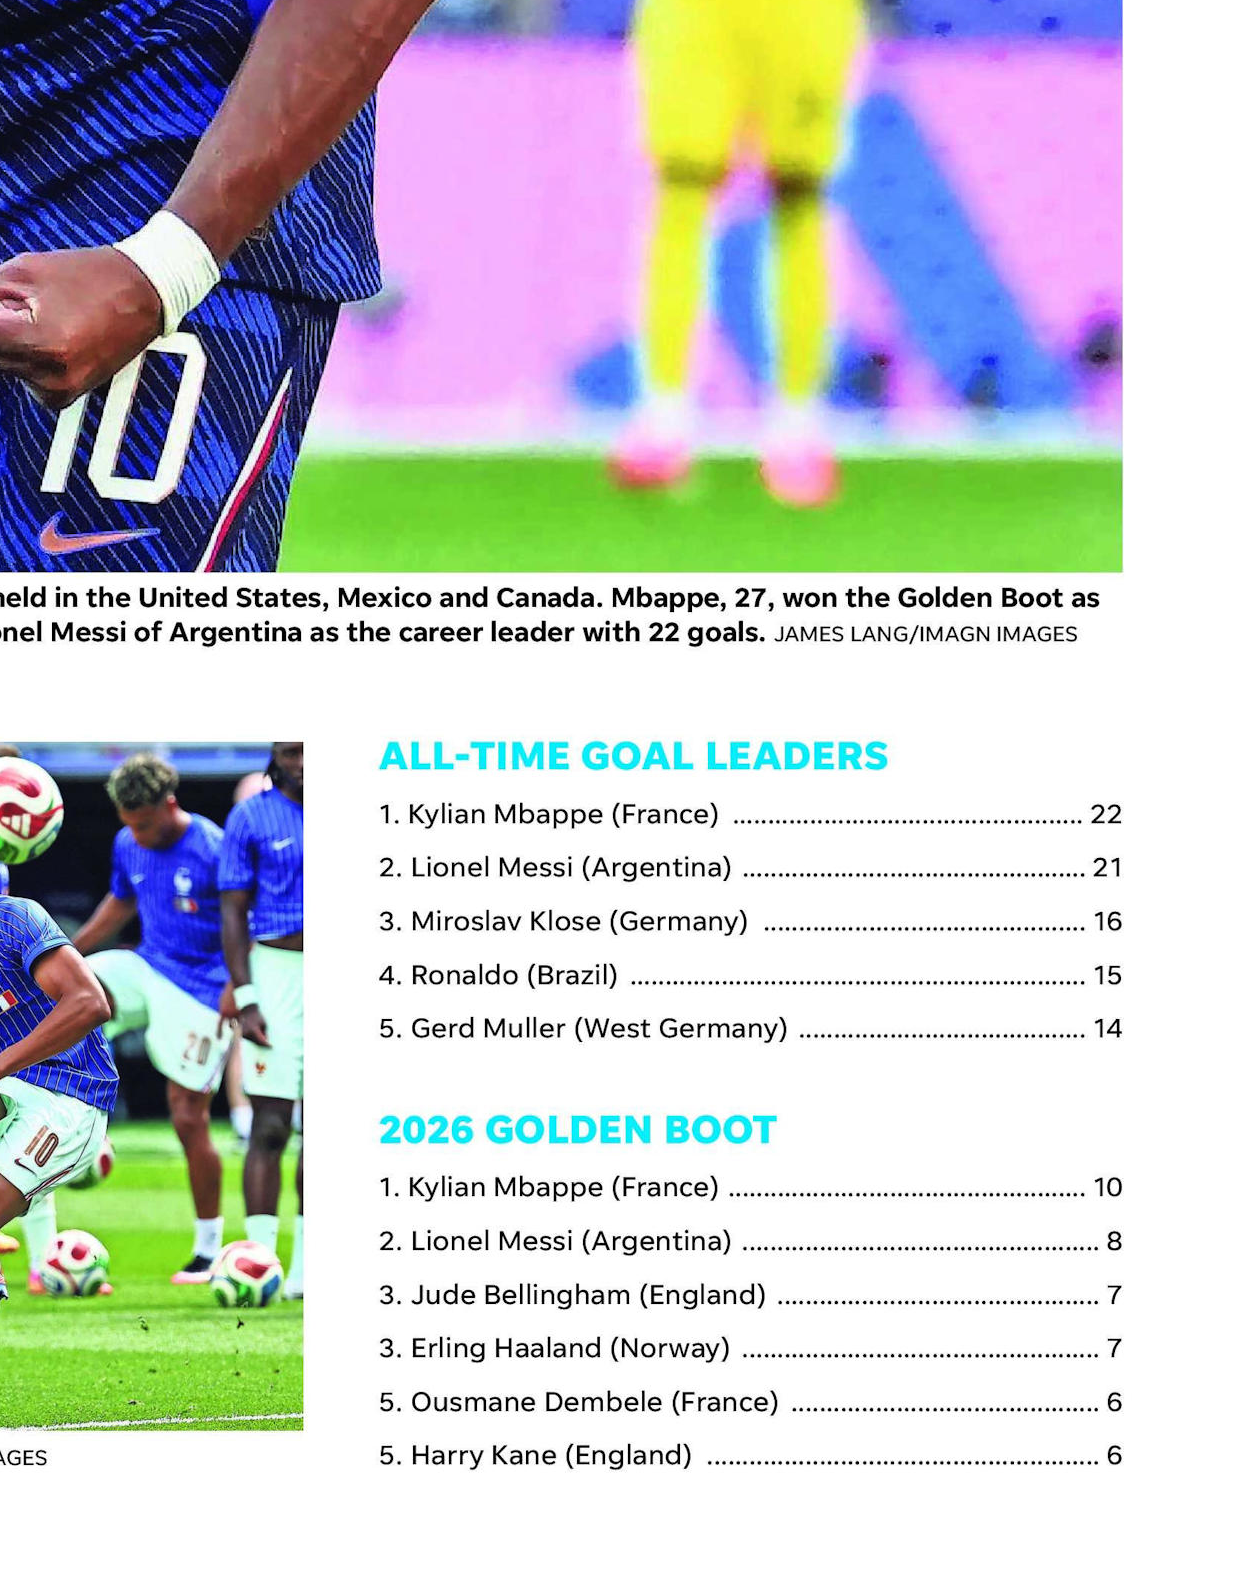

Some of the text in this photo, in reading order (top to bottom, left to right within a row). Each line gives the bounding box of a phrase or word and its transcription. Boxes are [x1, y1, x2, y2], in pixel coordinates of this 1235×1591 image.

[56, 586, 77, 607] in
[86, 586, 130, 607] the
[140, 586, 227, 607] United
[237, 588, 328, 611] States,
[339, 586, 431, 607] Mexico
[440, 586, 487, 607] and
[497, 586, 602, 607] Canada.
[613, 586, 726, 612] Mbappe,
[735, 588, 774, 611] 27,
[783, 592, 836, 608] won
[845, 586, 890, 607] the
[898, 586, 991, 608] Golden
[1002, 588, 1063, 608] Boot
[1072, 592, 1099, 607] as
[52, 621, 125, 642] Messi
[134, 621, 162, 642] of
[170, 621, 301, 647] Argentina
[310, 627, 338, 642] as
[347, 621, 390, 642] the
[400, 627, 483, 642] career
[492, 621, 574, 642] leader
[583, 621, 640, 642] with
[649, 622, 679, 641] 22
[688, 621, 765, 647] goals.
[775, 626, 843, 642] JAMES
[852, 625, 989, 644] LANG/IMAGN
[998, 626, 1077, 642] IMAGES
[379, 741, 887, 770] ALL-TIME GOAL LEADERS
[381, 803, 1121, 829] 1. Kylian Mbappe (France) 22
[380, 1017, 1122, 1043] 5. Gerd Muller (West Germany) 14
[182, 1031, 212, 1067] 20
[380, 1115, 777, 1144] 2026 GOLDEN BOOT
[24, 1124, 59, 1168] 10
[381, 1176, 1122, 1202] 1. Kylian Mbappe (France) 10
[380, 1444, 1122, 1470] 5. Harry Kane (England) 6
